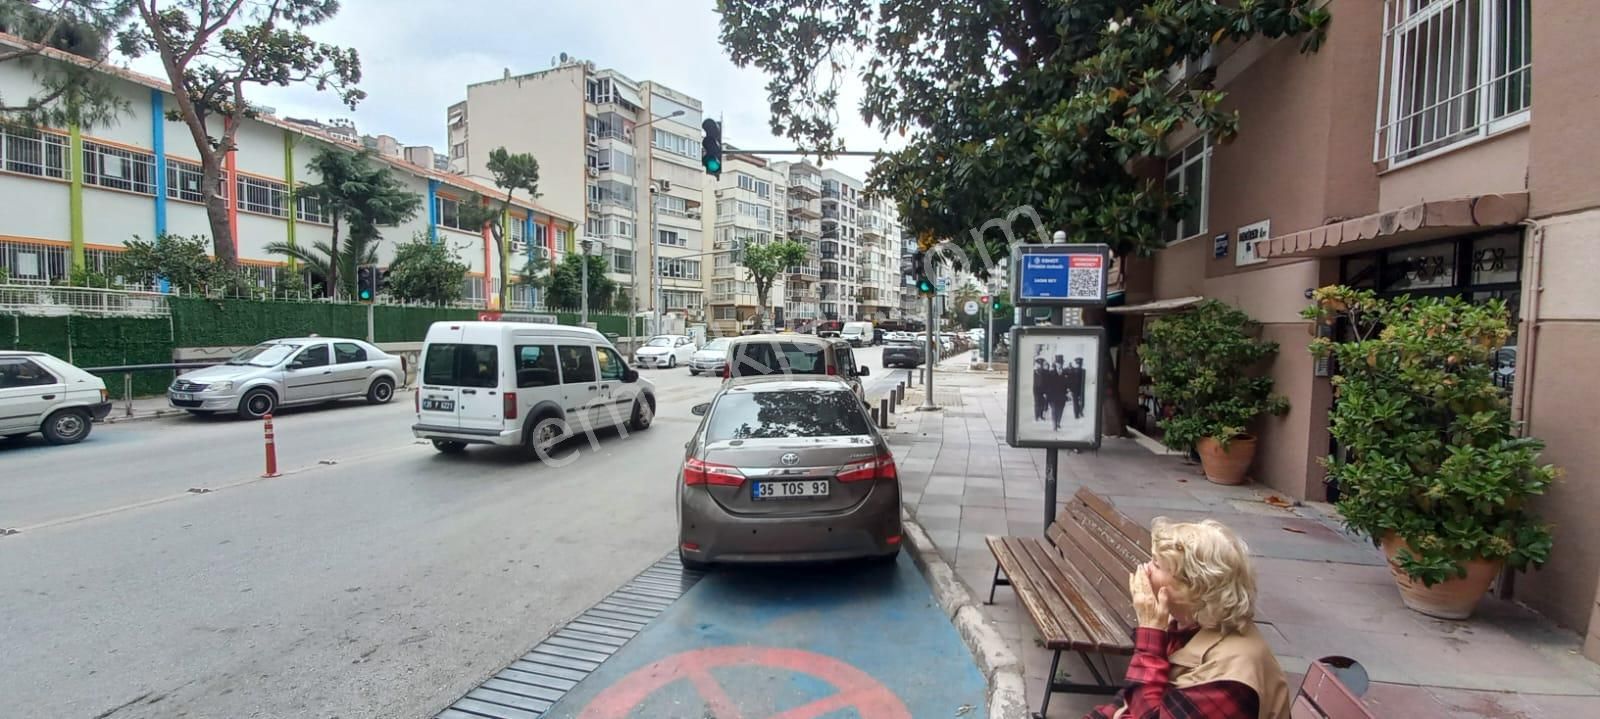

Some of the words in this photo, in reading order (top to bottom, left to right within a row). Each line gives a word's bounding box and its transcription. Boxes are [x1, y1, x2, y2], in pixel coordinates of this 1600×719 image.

[760, 483, 774, 496] 35
[781, 482, 804, 495] TOS
[812, 481, 827, 494] 93
